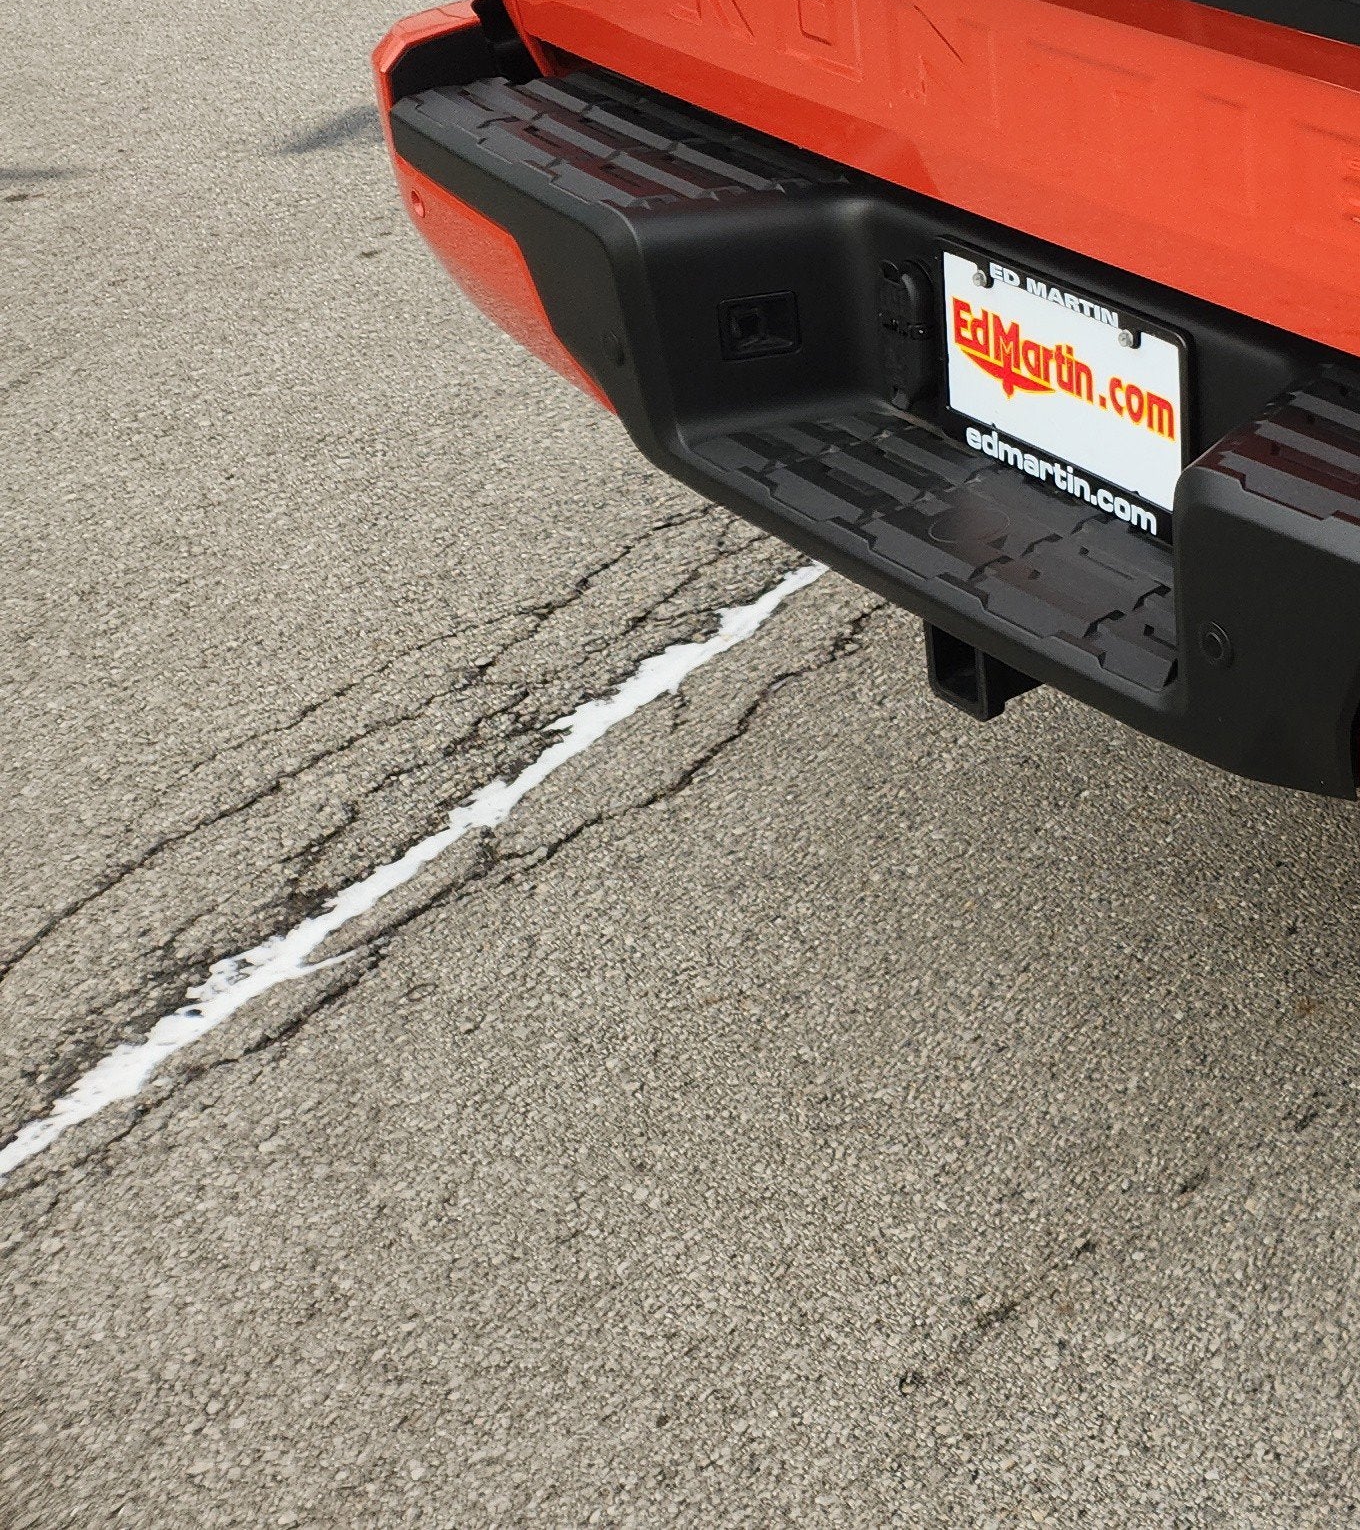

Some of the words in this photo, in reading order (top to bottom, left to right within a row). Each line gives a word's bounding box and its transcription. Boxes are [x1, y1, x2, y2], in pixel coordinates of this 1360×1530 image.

[989, 262, 1021, 288] ED
[1026, 278, 1119, 329] MARTIN
[965, 426, 1158, 537] edmartin.com
